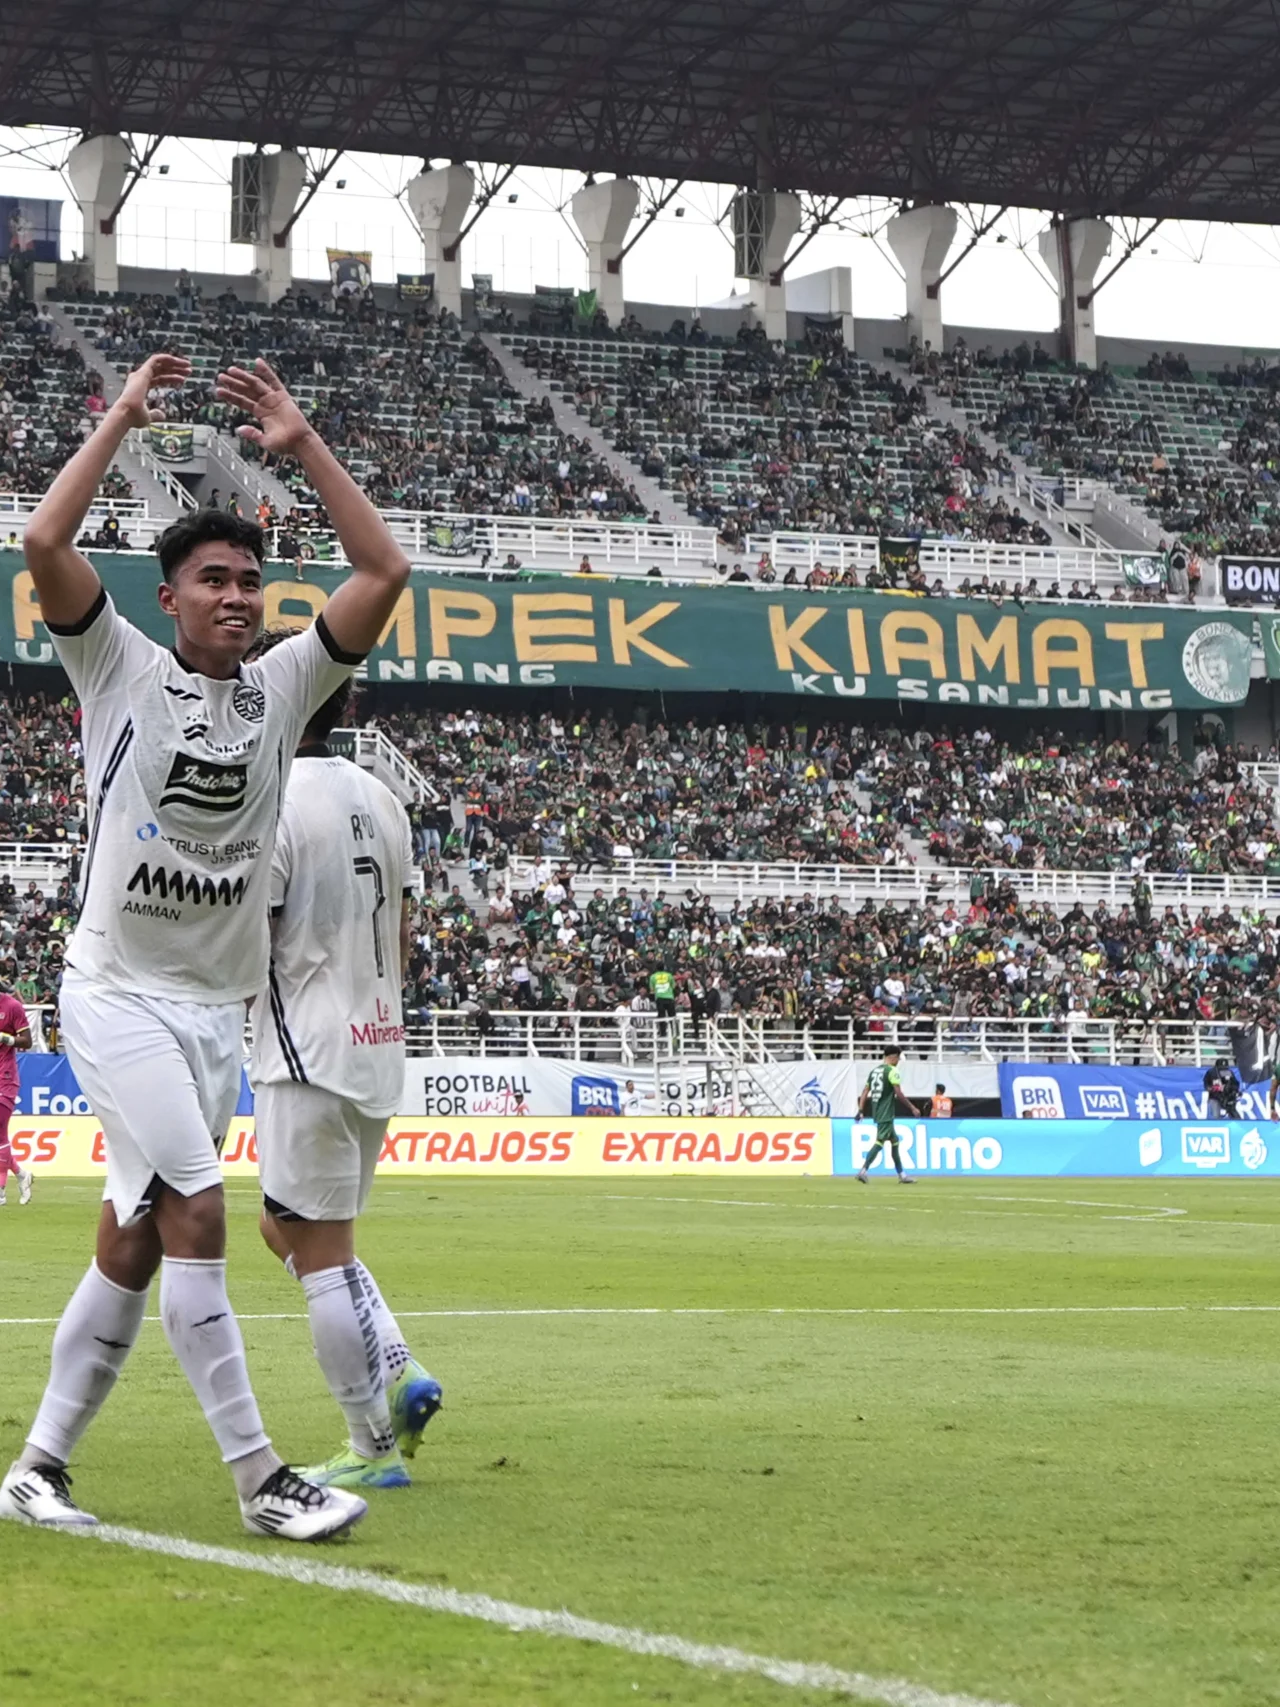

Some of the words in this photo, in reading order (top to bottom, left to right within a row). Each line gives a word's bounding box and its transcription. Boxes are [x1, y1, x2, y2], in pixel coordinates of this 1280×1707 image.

[1195, 622, 1240, 642] BONEK
[768, 605, 1164, 689] KIAMAT
[791, 672, 867, 698] KU
[897, 677, 1173, 709] SANJUNG
[224, 838, 262, 856] BANK
[122, 900, 182, 921] AMMAN
[353, 856, 387, 978] 7
[376, 997, 389, 1022] Le
[424, 1074, 532, 1095] FOOTBALL
[425, 1096, 468, 1116] FOR
[579, 1085, 613, 1106] BRI
[1021, 1087, 1054, 1106] BRI
[1087, 1094, 1121, 1110] VAR
[379, 1131, 574, 1163] XTRAJOSS
[602, 1130, 816, 1163] EXTRAJOSS
[851, 1124, 1003, 1170] BRImo
[1188, 1136, 1223, 1154] VAR
